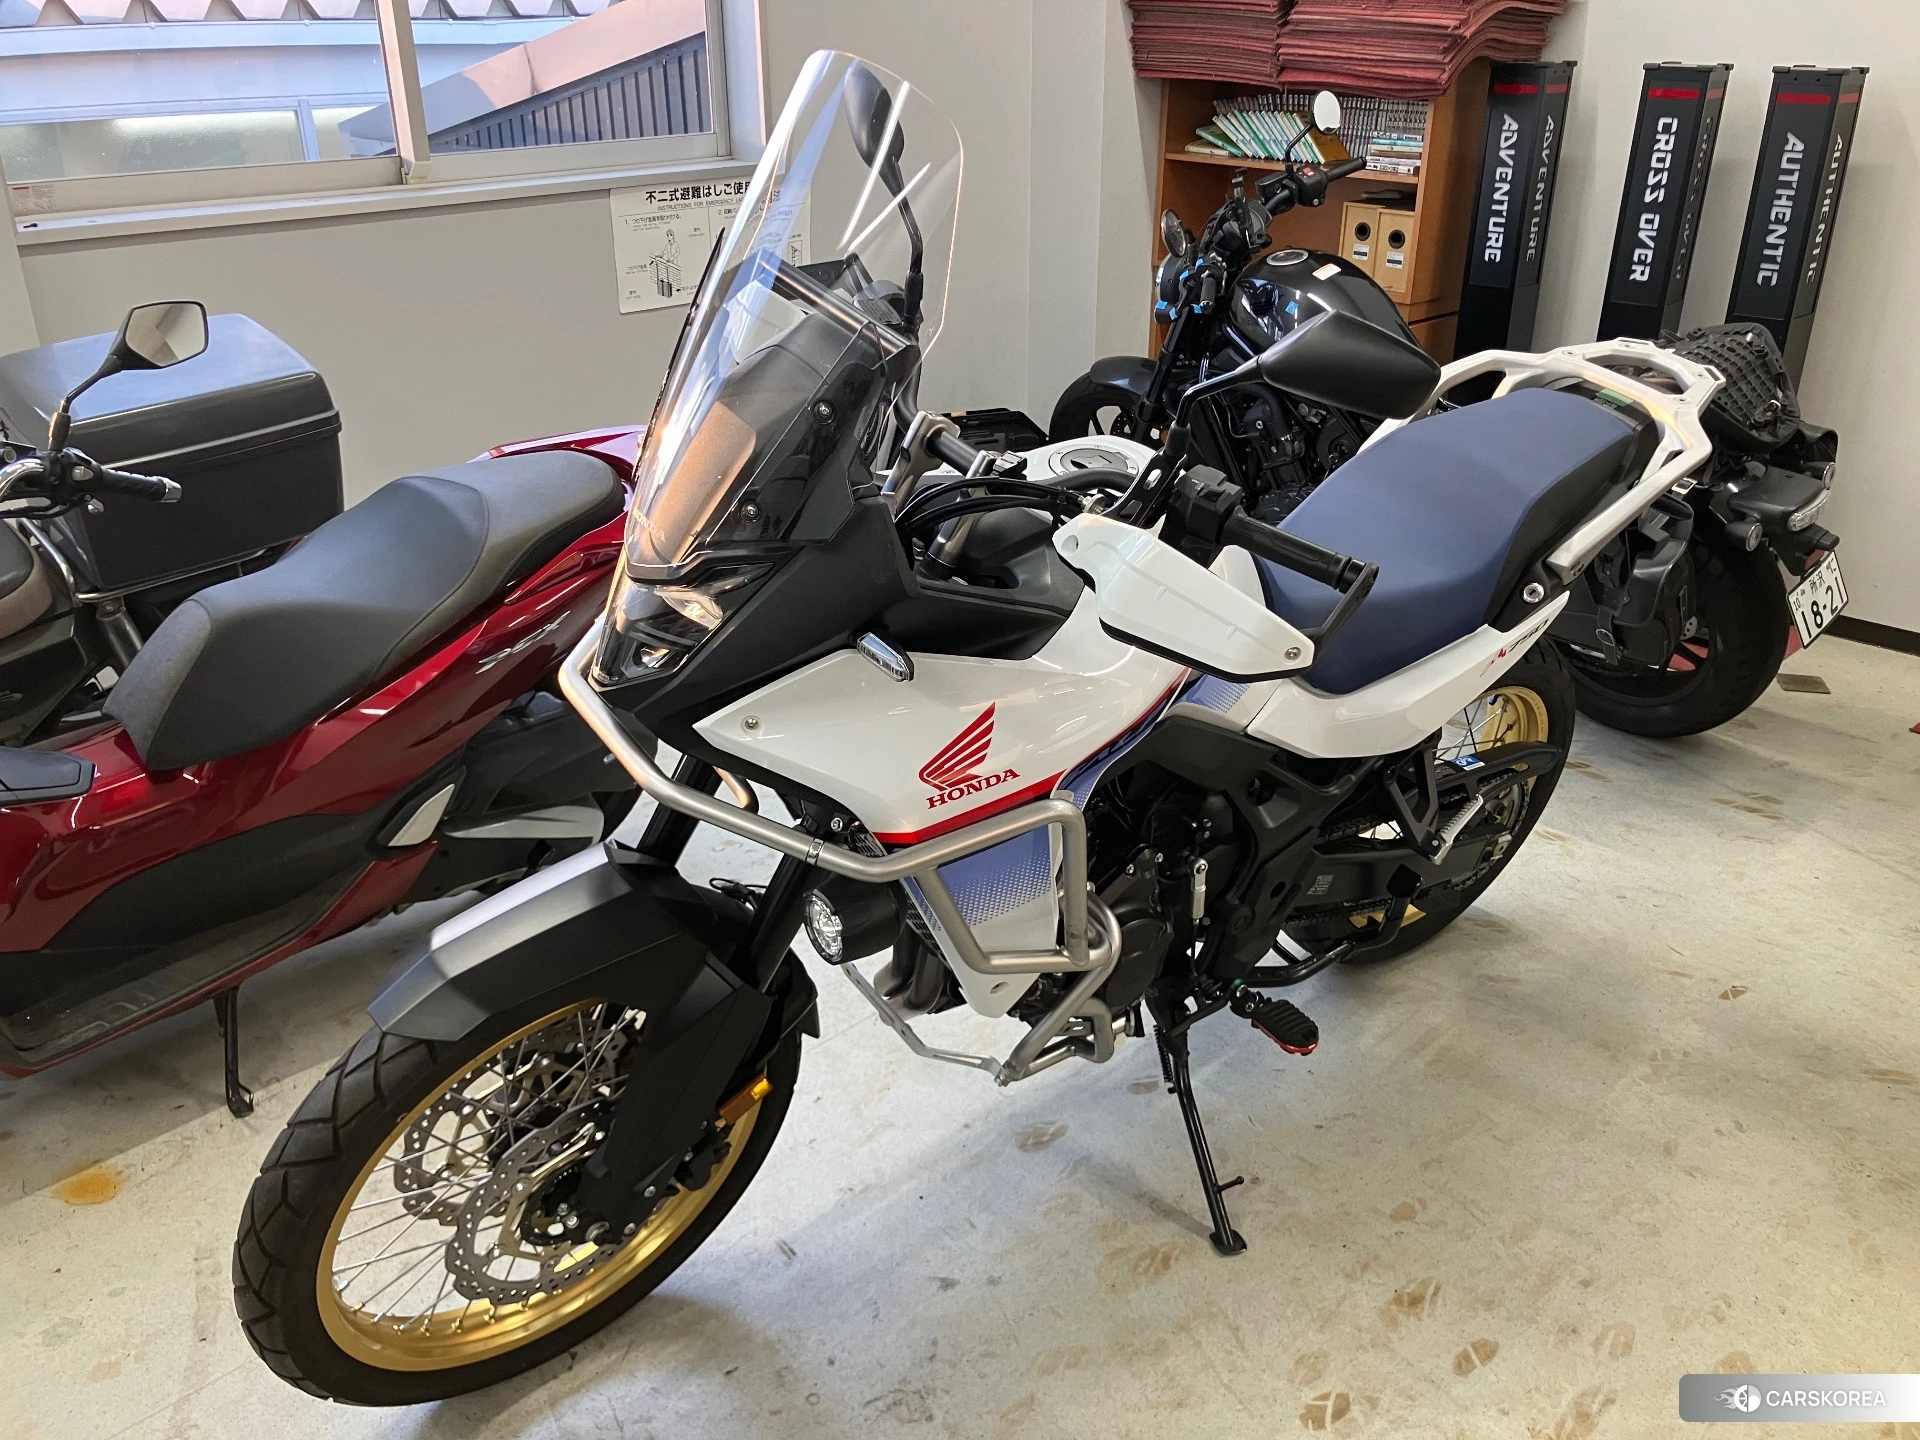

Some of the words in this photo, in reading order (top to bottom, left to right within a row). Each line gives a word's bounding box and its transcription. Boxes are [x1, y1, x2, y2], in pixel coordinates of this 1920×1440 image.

[1484, 113, 1519, 264] ADVENTURE
[1526, 115, 1555, 262] ADVENTURE
[1643, 116, 1679, 204] CROSS
[657, 202, 692, 211] INSTRUCTIONS
[705, 198, 734, 206] EMERGENCY
[1756, 131, 1805, 288] AUTHENTIC
[1806, 133, 1843, 286] AUTHENTIC
[1628, 212, 1660, 283] OVER
[632, 505, 666, 543] HONDA
[1801, 576, 1844, 639] 18-21
[925, 768, 1021, 810] HONDA
